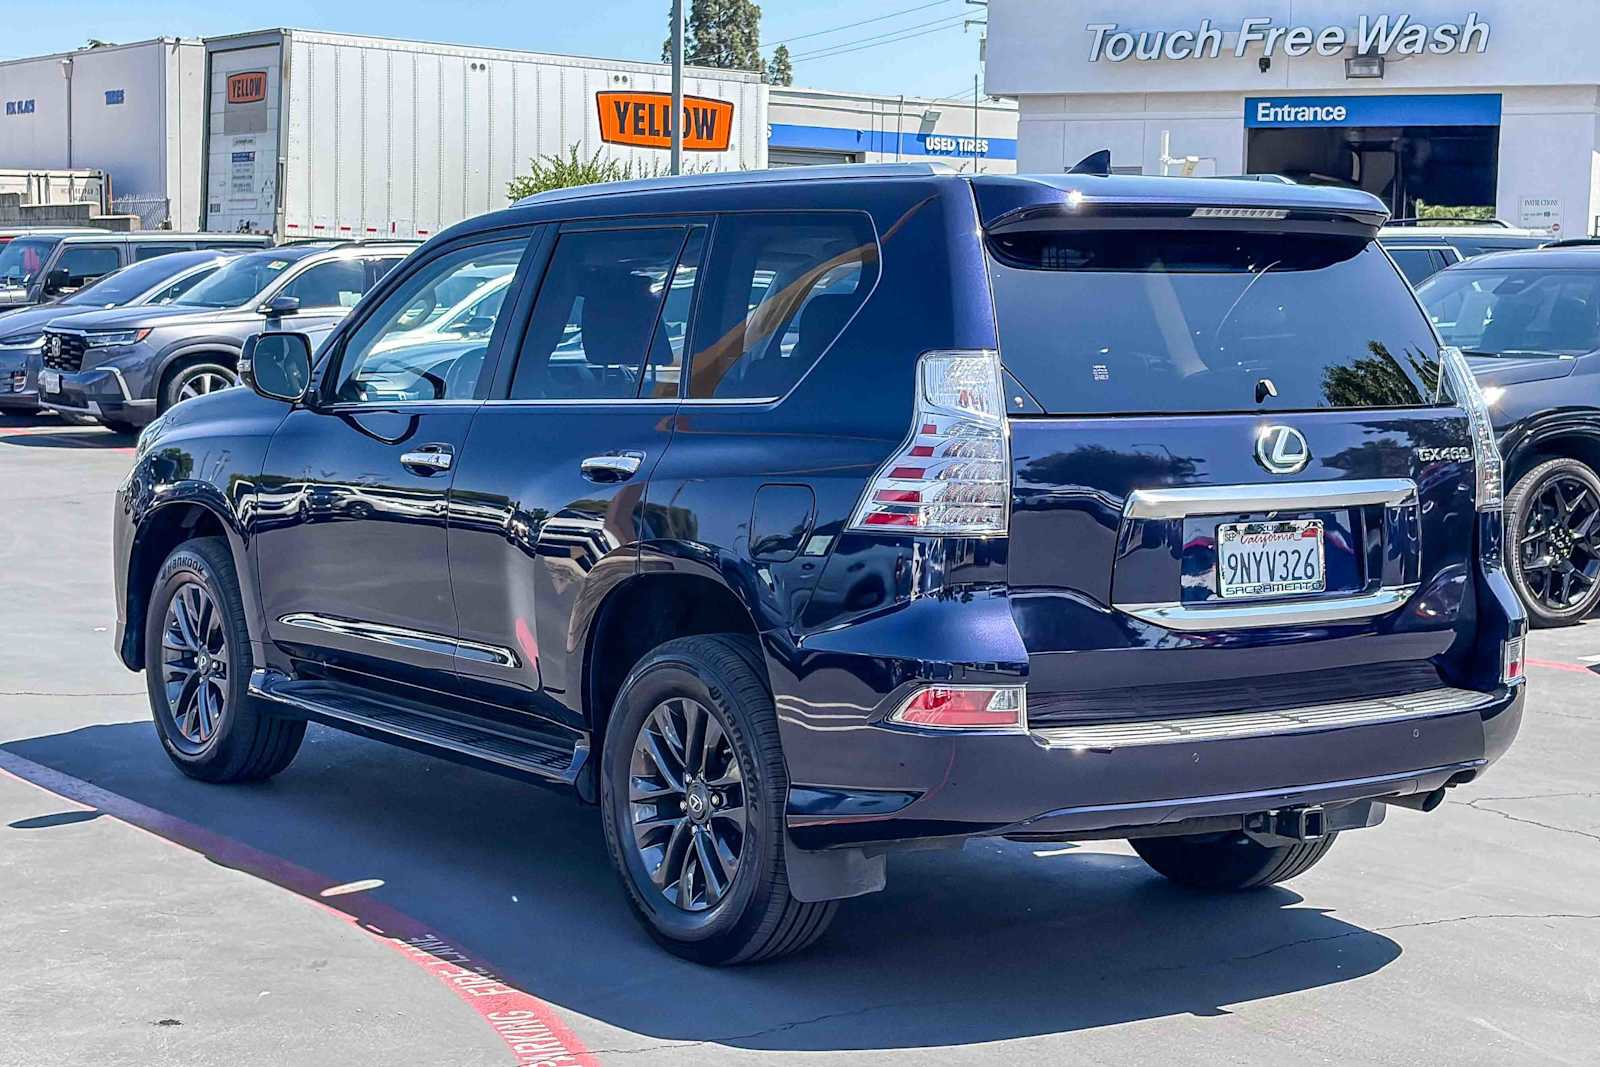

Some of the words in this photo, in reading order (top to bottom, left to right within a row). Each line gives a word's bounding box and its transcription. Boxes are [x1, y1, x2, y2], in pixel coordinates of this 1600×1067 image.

[1086, 19, 1222, 62] Touch
[1235, 16, 1345, 58] Free
[1357, 12, 1491, 56] Wash
[231, 77, 262, 98] YELLOW
[1256, 102, 1347, 122] Entrance
[925, 136, 956, 152] USED
[958, 138, 989, 153] TIRES
[1240, 532, 1298, 548] California
[1227, 548, 1315, 584] 9NYV326
[1225, 581, 1323, 596] SACRAMENTO
